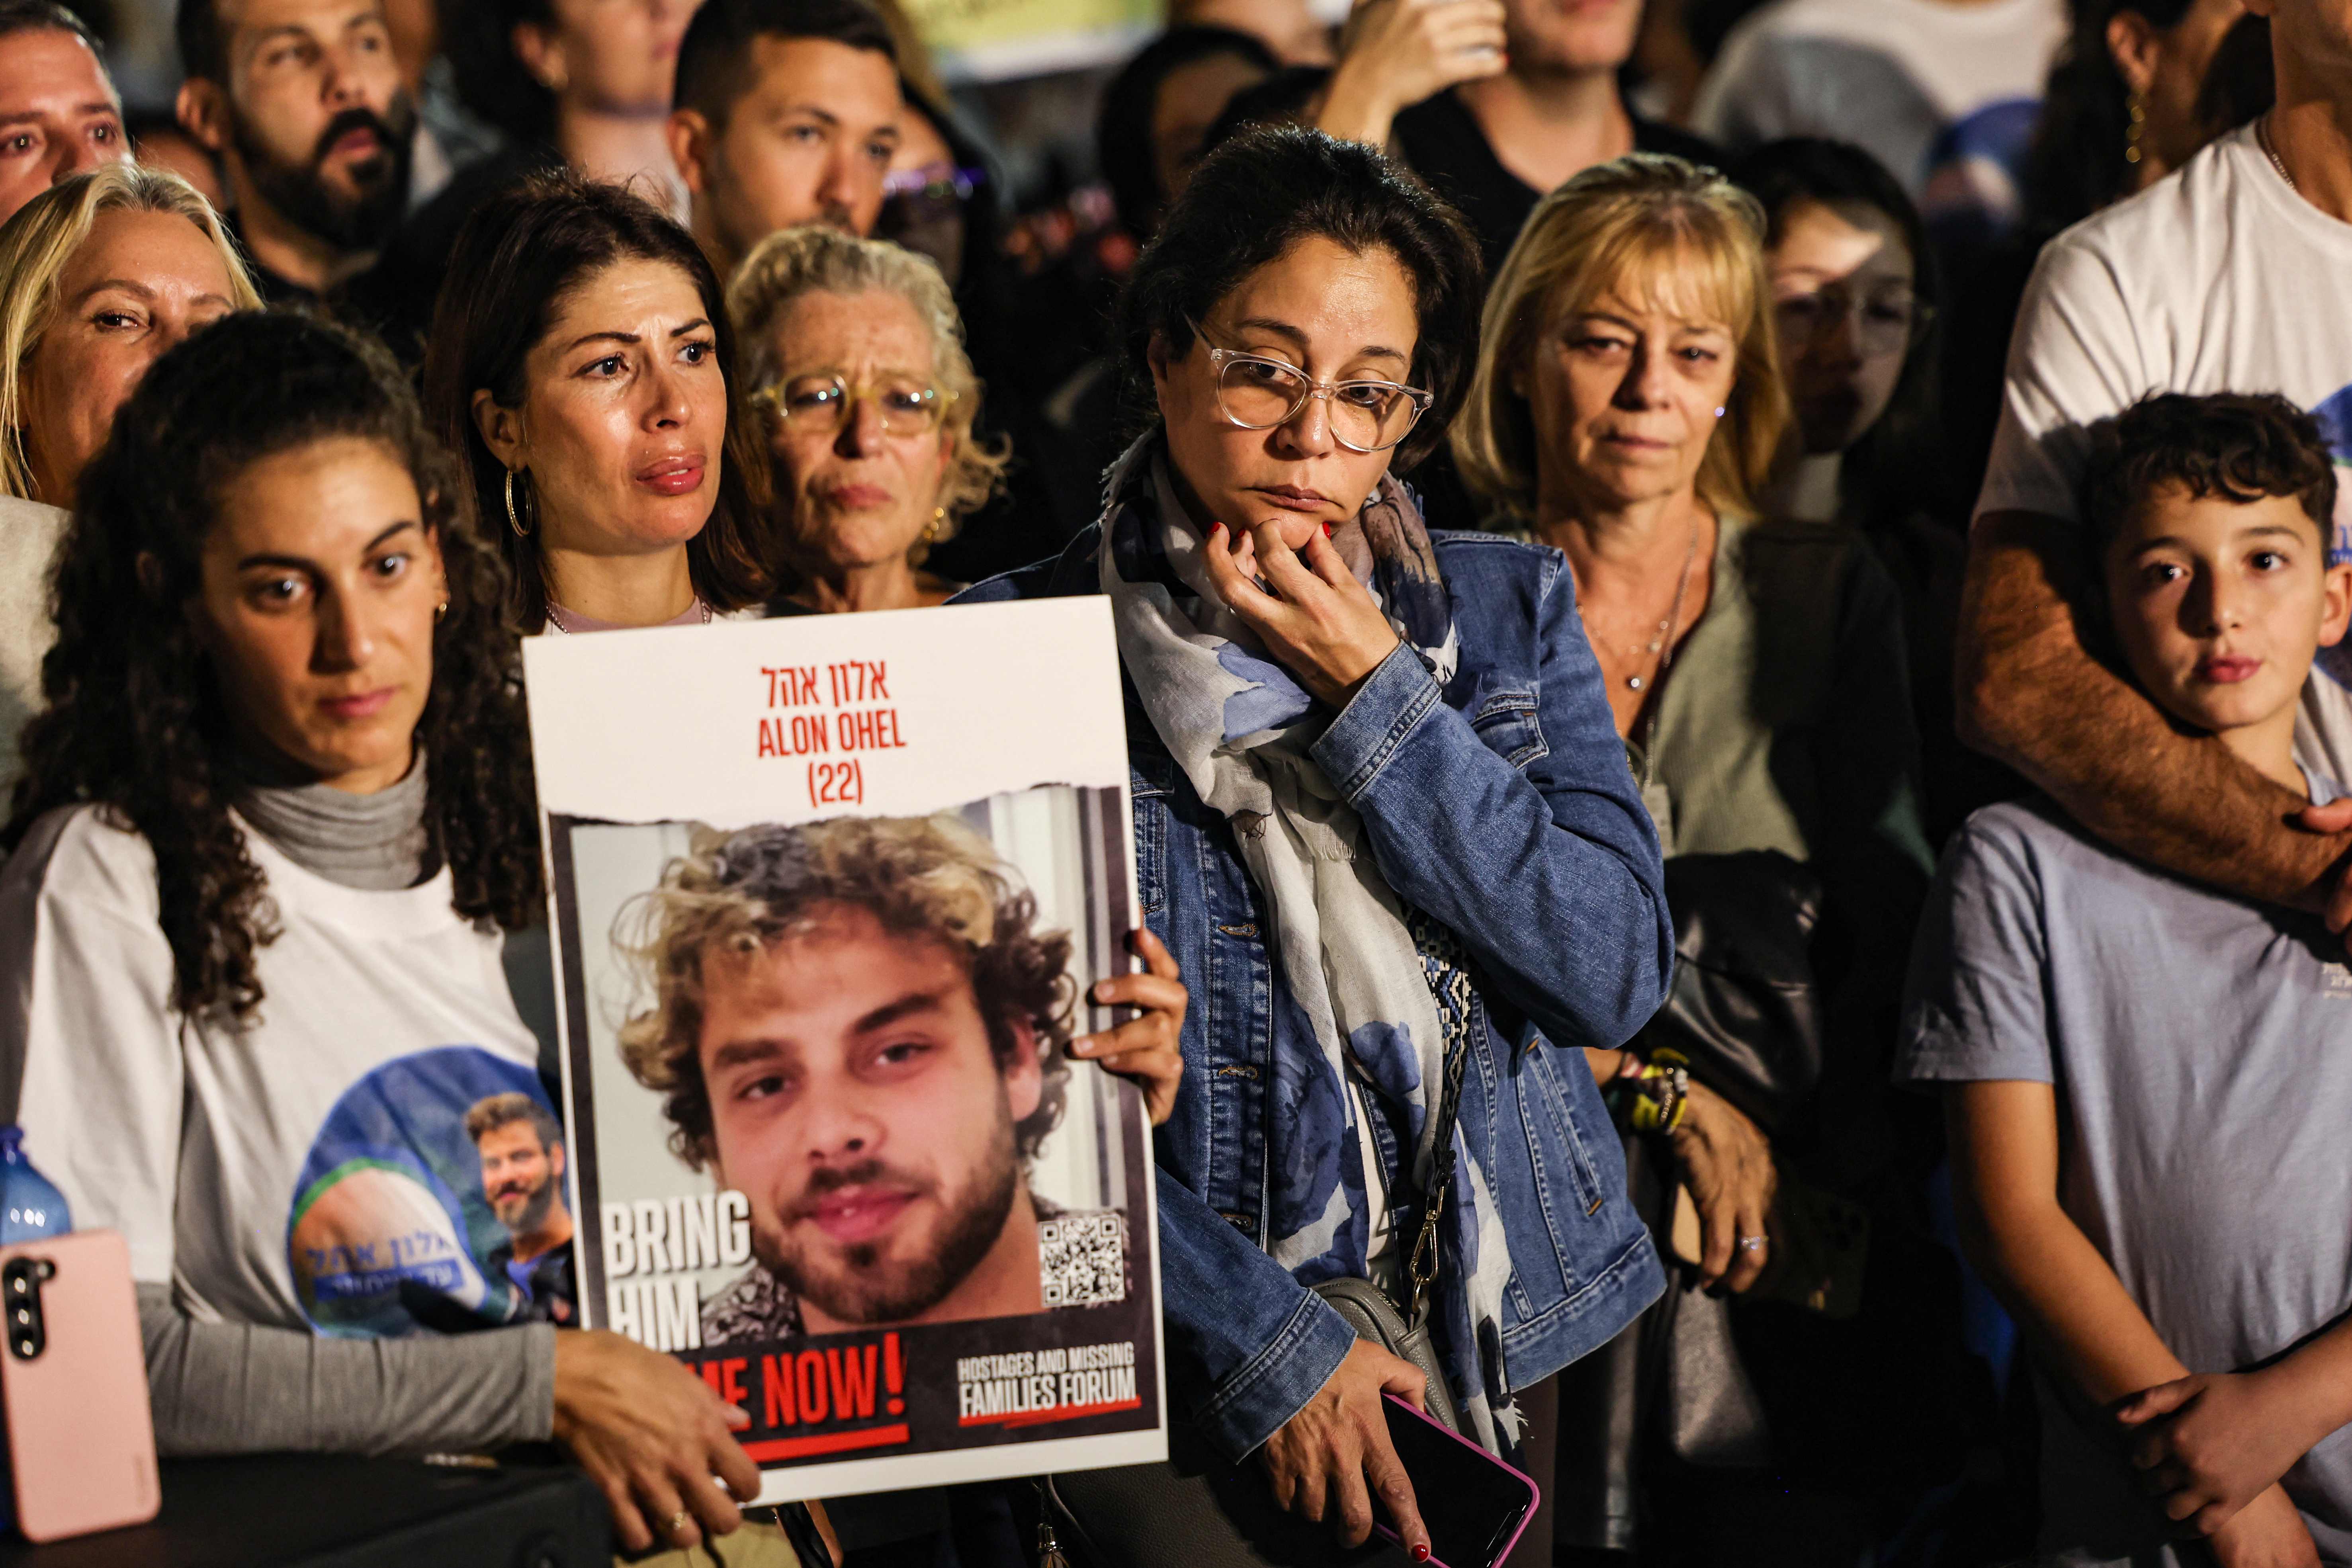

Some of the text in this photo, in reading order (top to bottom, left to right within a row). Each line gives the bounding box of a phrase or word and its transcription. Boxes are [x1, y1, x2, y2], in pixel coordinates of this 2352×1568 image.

[761, 660, 890, 708] אלון אהל
[759, 708, 907, 758] ALON OHEL
[808, 758, 863, 809] (22)
[603, 1190, 752, 1277] BRING
[608, 1277, 702, 1353] HIM
[761, 1331, 906, 1429] NOW!
[957, 1341, 1135, 1382] HOSTAGES AND MISSING
[959, 1366, 1137, 1418] FAMILIES FORUM
